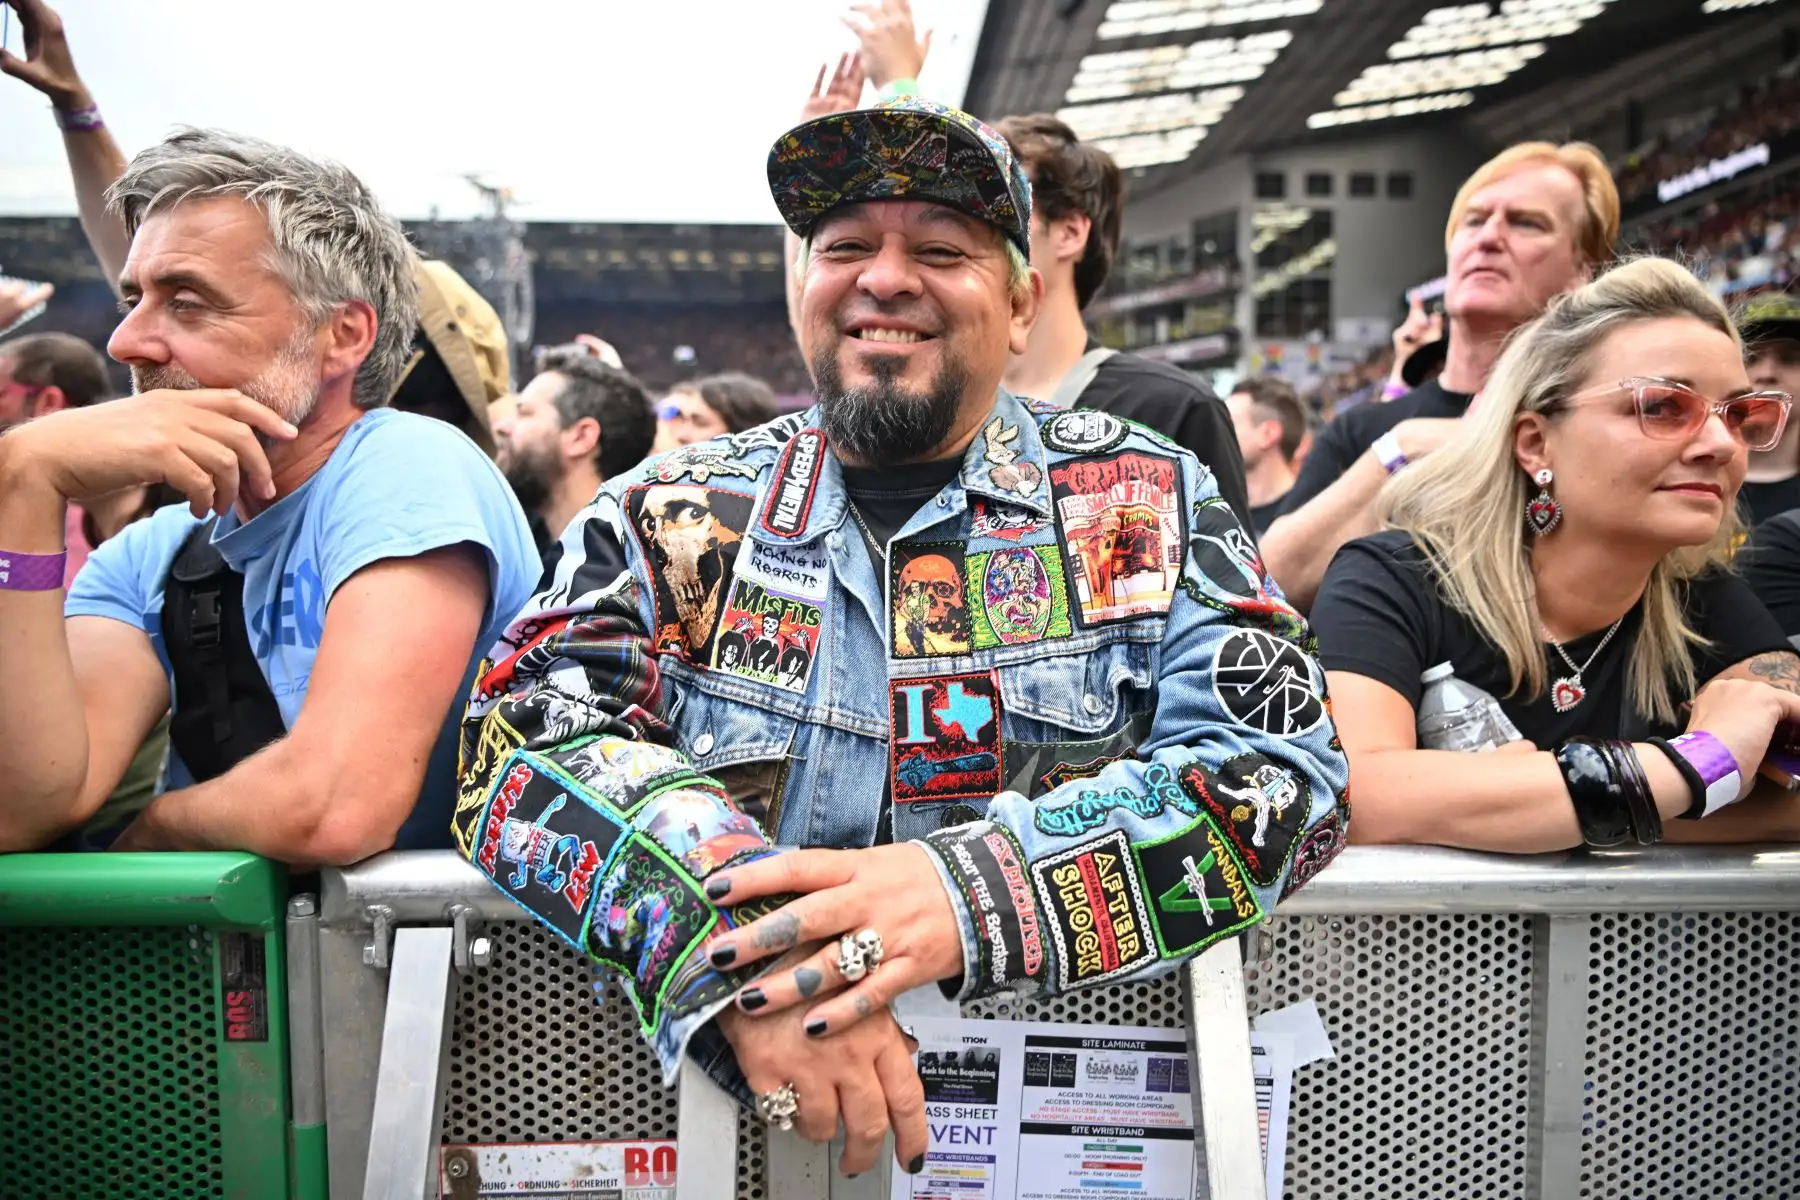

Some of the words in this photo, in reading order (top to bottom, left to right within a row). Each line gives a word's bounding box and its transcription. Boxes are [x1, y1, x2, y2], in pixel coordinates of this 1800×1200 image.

[790, 433, 818, 480] SPEED
[1067, 454, 1175, 495] CRAMPS
[772, 483, 809, 530] METAL
[1086, 487, 1123, 513] SMELL
[732, 579, 822, 627] MISFITS
[896, 684, 936, 744] I
[478, 763, 533, 877] MURPHY'S
[533, 833, 552, 867] BEER
[564, 841, 602, 915] LAW
[950, 842, 978, 875] BEAT
[972, 875, 994, 911] THE
[985, 912, 1009, 984] BASTARDS
[983, 832, 1042, 976] EXPLOITED
[1052, 864, 1102, 977] SHOCK
[1094, 851, 1140, 962] AFTER
[1082, 1039, 1100, 1047] SITE
[1102, 1040, 1146, 1050] LAMINATE
[960, 1068, 996, 1079] Beginning
[925, 1106, 950, 1118] ASS
[955, 1108, 998, 1120] SHEET
[1108, 1093, 1140, 1101] WORKING
[1141, 1110, 1180, 1118] WRISTBAND
[927, 1124, 997, 1145] VENT
[1071, 1125, 1089, 1134] SITE
[1091, 1126, 1145, 1136] WRISTBAND
[946, 1154, 989, 1163] WRISTBANDS
[479, 1181, 506, 1191] HUNG
[518, 1180, 560, 1190] ORDNUNG
[571, 1179, 618, 1189] SICHERHEIT
